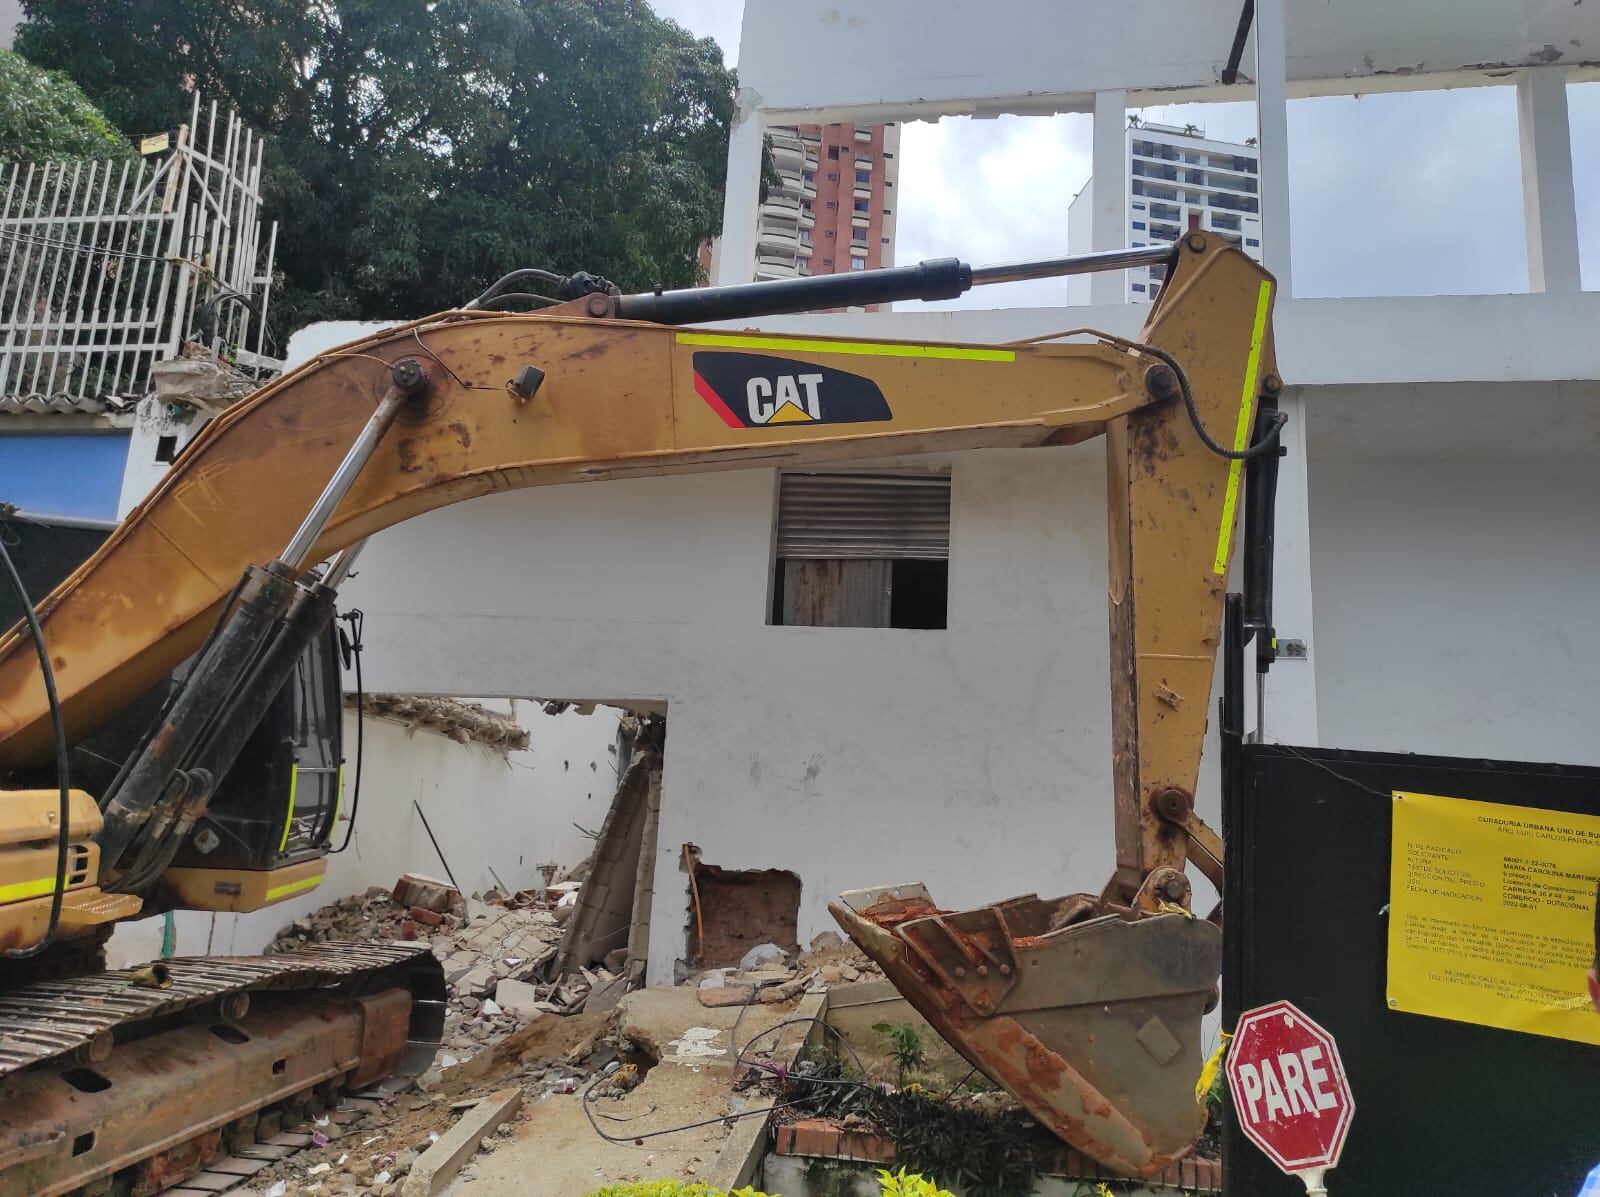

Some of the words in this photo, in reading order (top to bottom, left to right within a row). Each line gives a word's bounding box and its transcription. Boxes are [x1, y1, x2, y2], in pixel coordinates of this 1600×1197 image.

[746, 373, 823, 424] CAT
[1523, 822, 1555, 832] URBANA
[1557, 827, 1574, 835] UNO
[1575, 829, 1588, 837] DE
[1503, 864, 1526, 872] MARIA
[1528, 867, 1565, 877] CAROLINA
[1502, 885, 1537, 895] CARRERA
[1502, 893, 1541, 903] COMERCIO
[1546, 899, 1591, 911] DOTACIONAL
[1238, 1045, 1338, 1124] PARE
